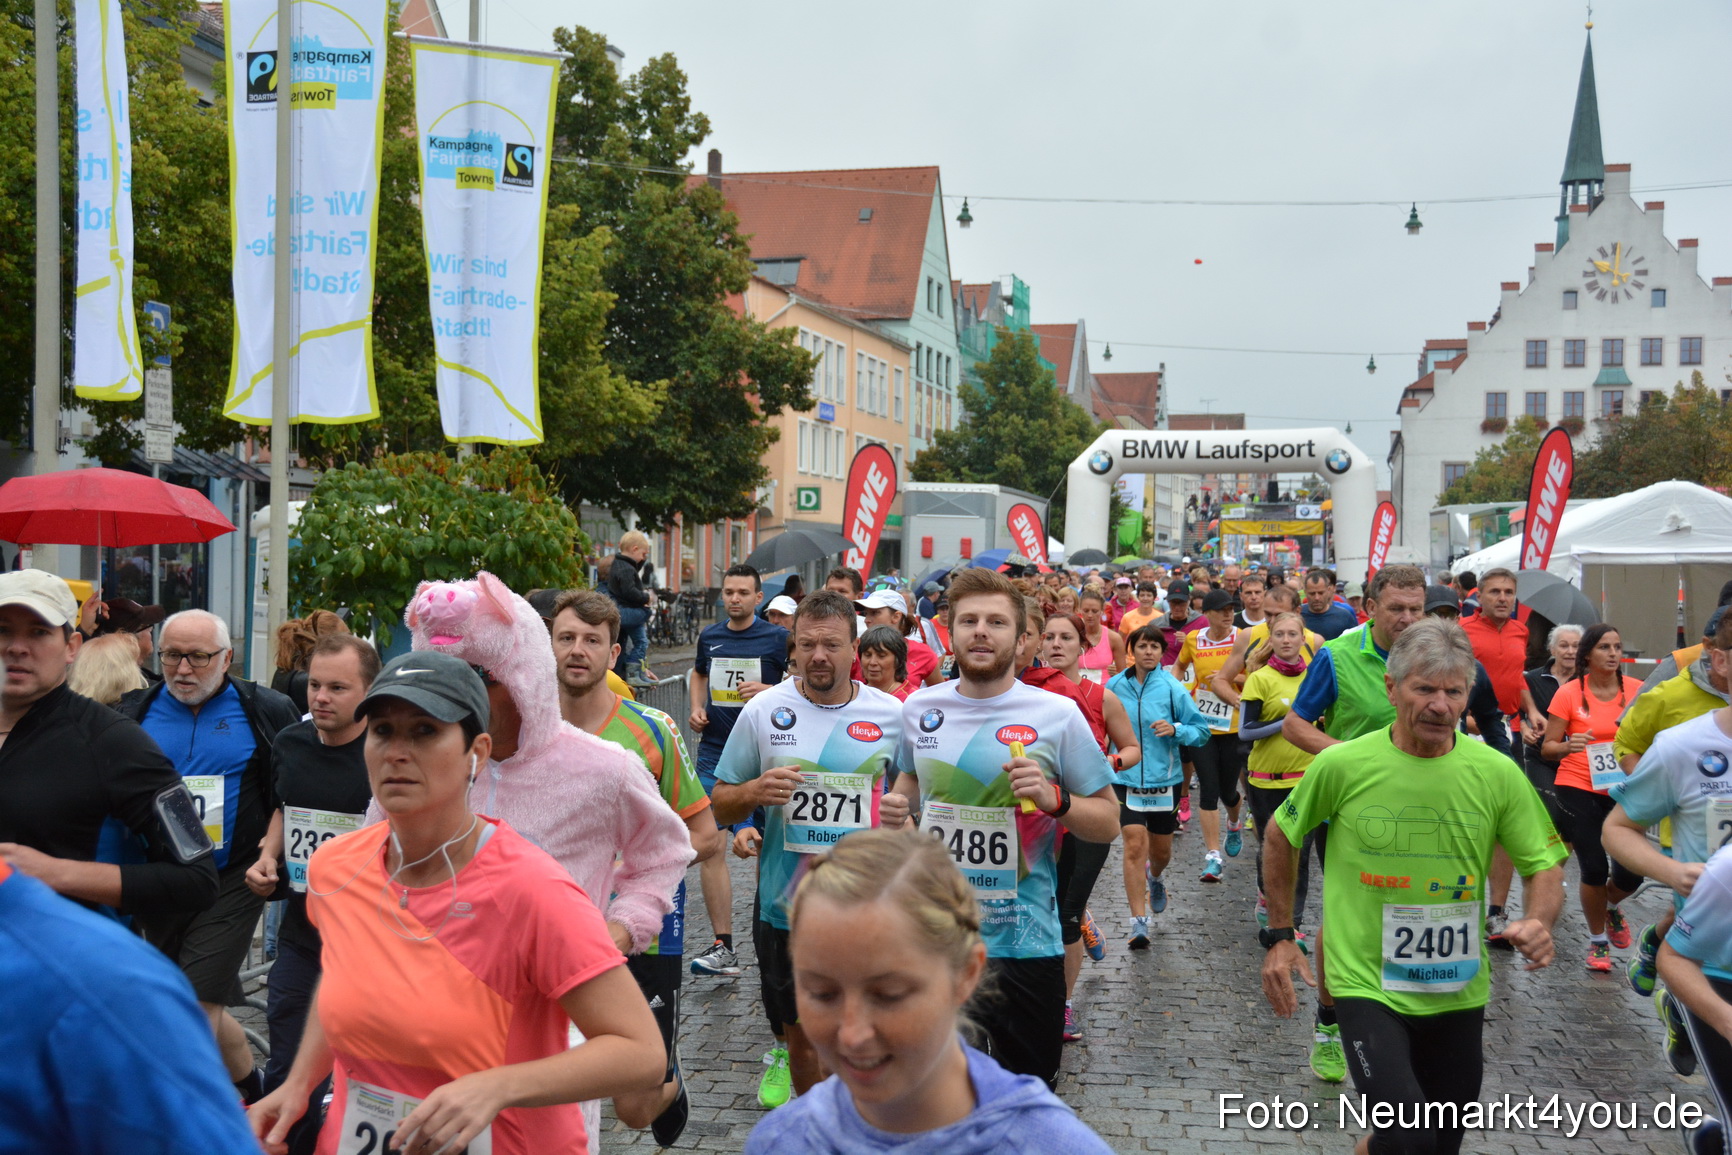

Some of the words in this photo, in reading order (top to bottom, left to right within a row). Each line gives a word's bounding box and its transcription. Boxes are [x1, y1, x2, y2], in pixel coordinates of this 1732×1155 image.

[429, 137, 493, 152] Kampagne
[430, 150, 498, 168] Fairtrade
[458, 172, 494, 185] Towns
[429, 252, 464, 274] Wir
[471, 255, 507, 278] sind
[1122, 439, 1189, 459] BMW
[1195, 438, 1316, 463] Laufsport
[800, 490, 817, 508] D
[845, 461, 889, 569] REWE
[1524, 449, 1567, 570] REWE
[1260, 523, 1284, 532] ZIEL
[1371, 509, 1393, 571] REWE
[725, 670, 745, 688] 75
[1198, 699, 1229, 717] 2741
[770, 733, 797, 741] PARTL
[852, 725, 879, 738] Hervis
[1001, 729, 1033, 741] Hervis
[917, 736, 939, 745] PARTL
[186, 779, 215, 788] OCK
[824, 775, 865, 787] BOCK
[792, 791, 862, 823] 2871
[315, 813, 357, 827] BOCK
[927, 812, 955, 821] NeuerMarkt
[960, 808, 1008, 822] BOCK
[294, 867, 307, 880] Ch
[968, 873, 998, 887] nder
[1360, 871, 1411, 889] MERZ
[1430, 905, 1473, 919] BOCK
[1394, 922, 1469, 959] 2401
[1407, 966, 1459, 980] Michael
[356, 1098, 395, 1118] NeuerMarkt
